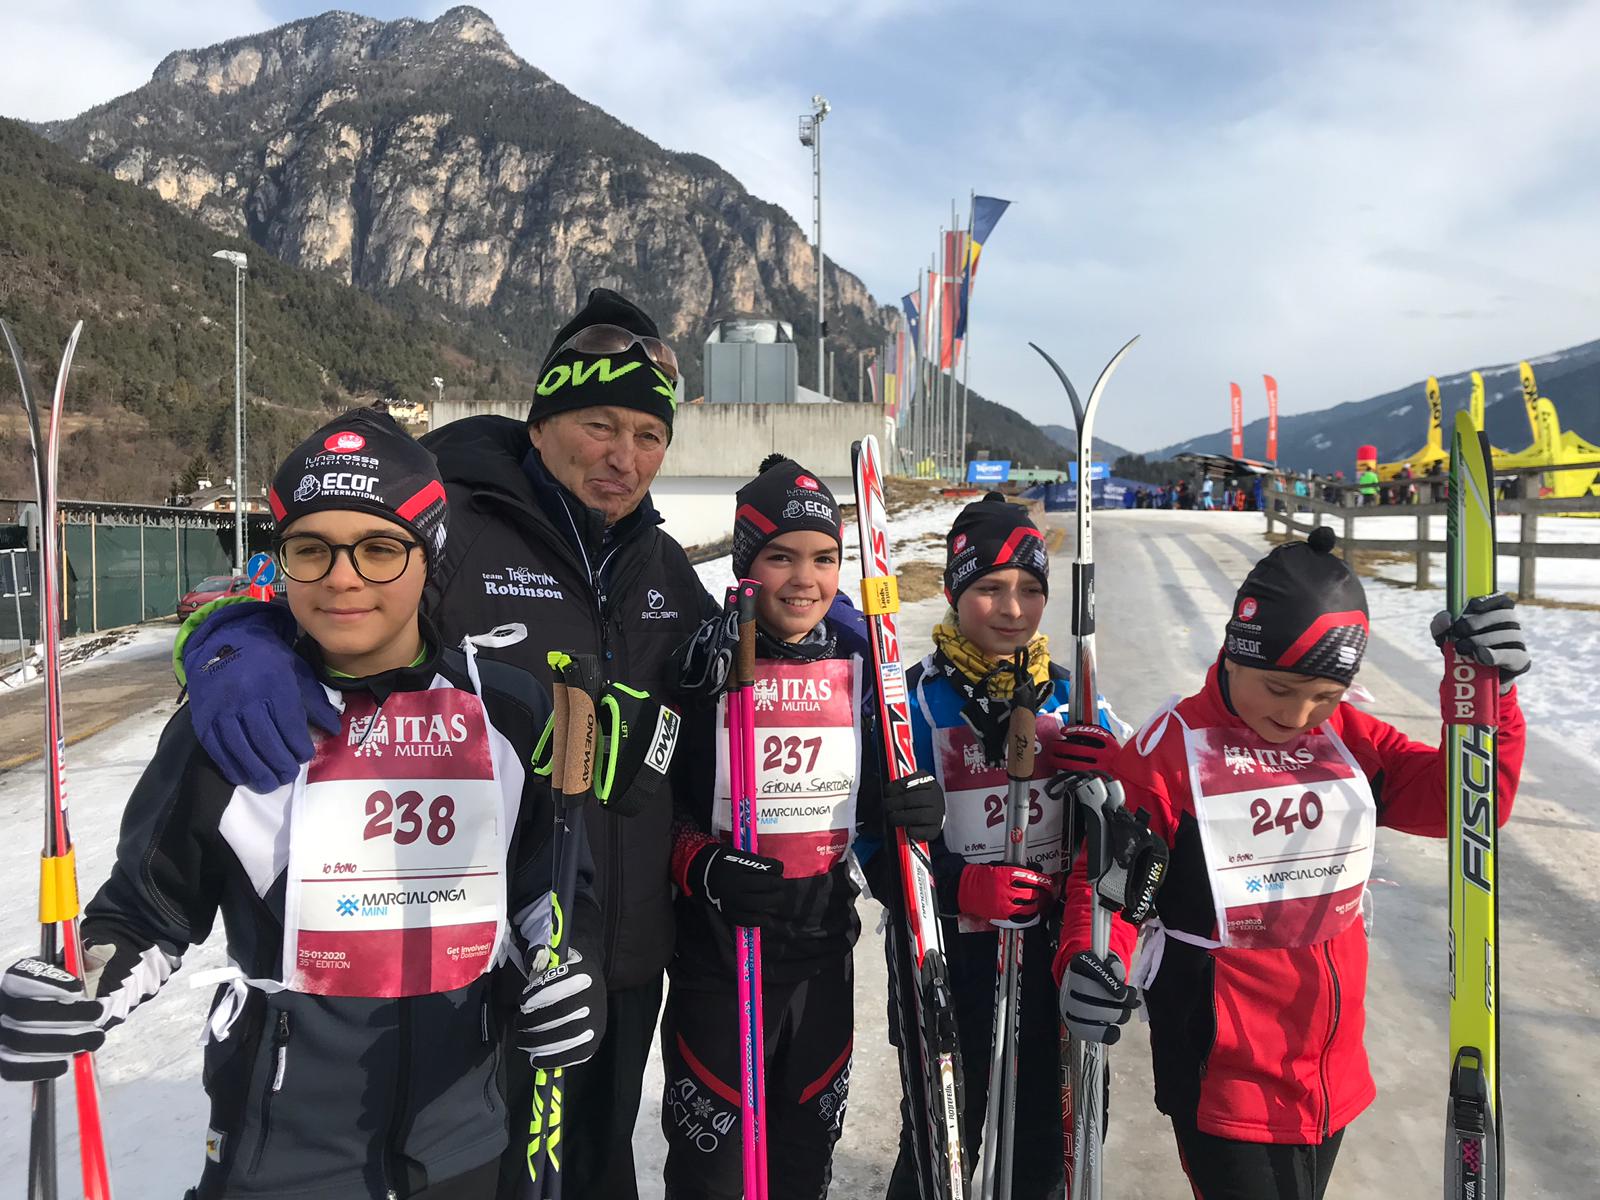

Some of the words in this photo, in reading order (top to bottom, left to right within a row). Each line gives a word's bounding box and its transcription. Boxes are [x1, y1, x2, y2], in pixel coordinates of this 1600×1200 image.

[305, 454, 380, 466] lunarossa
[321, 490, 385, 503] INTERNATIONAL
[482, 572, 503, 580] team
[484, 581, 564, 600] Robinson
[781, 678, 832, 701] ITAS
[781, 701, 821, 711] MUTUA
[394, 713, 468, 743] ITAS
[1063, 726, 1109, 738] SWIX
[394, 745, 453, 757] MUTUA
[763, 735, 822, 775] 237
[1254, 748, 1314, 766] ITAS
[1261, 765, 1309, 774] MUTUA
[761, 805, 831, 818] MARCIALONGA
[984, 788, 1044, 829] 23
[1249, 791, 1323, 837] 240
[1461, 724, 1493, 895] FISCH
[363, 790, 456, 846] 238
[723, 855, 773, 871] SWIX
[1263, 863, 1347, 883] MARCIALONGA
[1264, 882, 1285, 892] MINI
[362, 888, 466, 906] MARCIALONGA
[361, 907, 389, 917] MINI
[316, 960, 350, 969] EDITION
[1079, 954, 1121, 991] SALOMON
[666, 1087, 718, 1153] SCHIO
